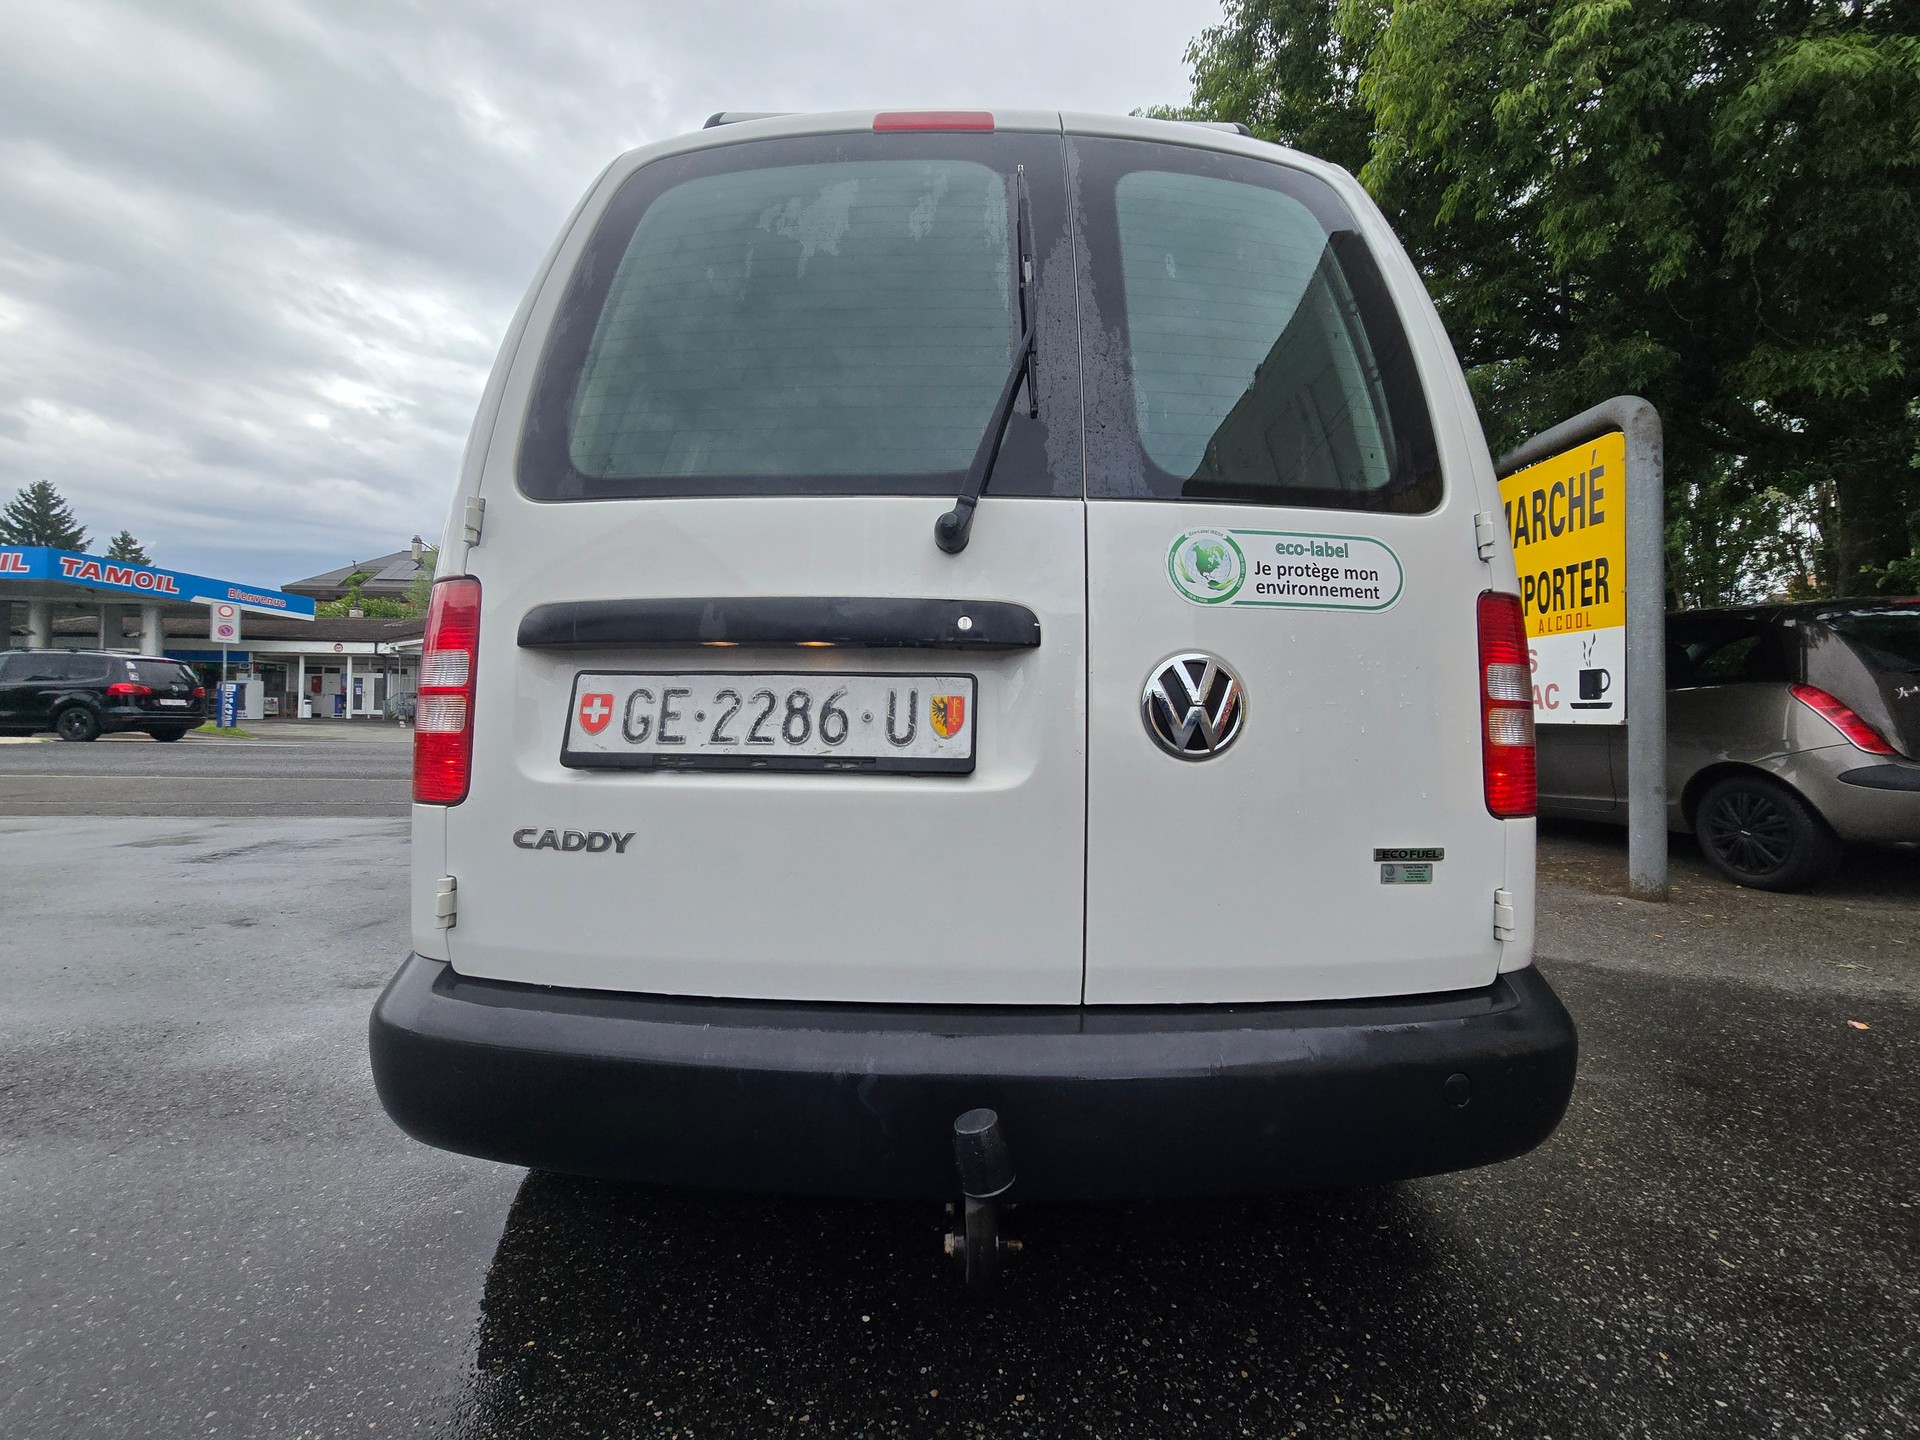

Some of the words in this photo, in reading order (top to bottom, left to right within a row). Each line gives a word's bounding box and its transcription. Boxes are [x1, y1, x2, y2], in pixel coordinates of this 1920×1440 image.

[1275, 540, 1349, 559] eco-label
[60, 556, 180, 594] TAMOIL
[1254, 560, 1272, 576] Je
[1276, 561, 1339, 582] protège
[1344, 566, 1379, 581] mon
[228, 587, 286, 609] Bienvenue
[1255, 580, 1380, 599] environnement
[1518, 557, 1610, 617] PORTER
[1538, 611, 1592, 634] ALCOOL
[513, 827, 637, 854] CADDY
[1381, 849, 1439, 859] ECOFUEL
